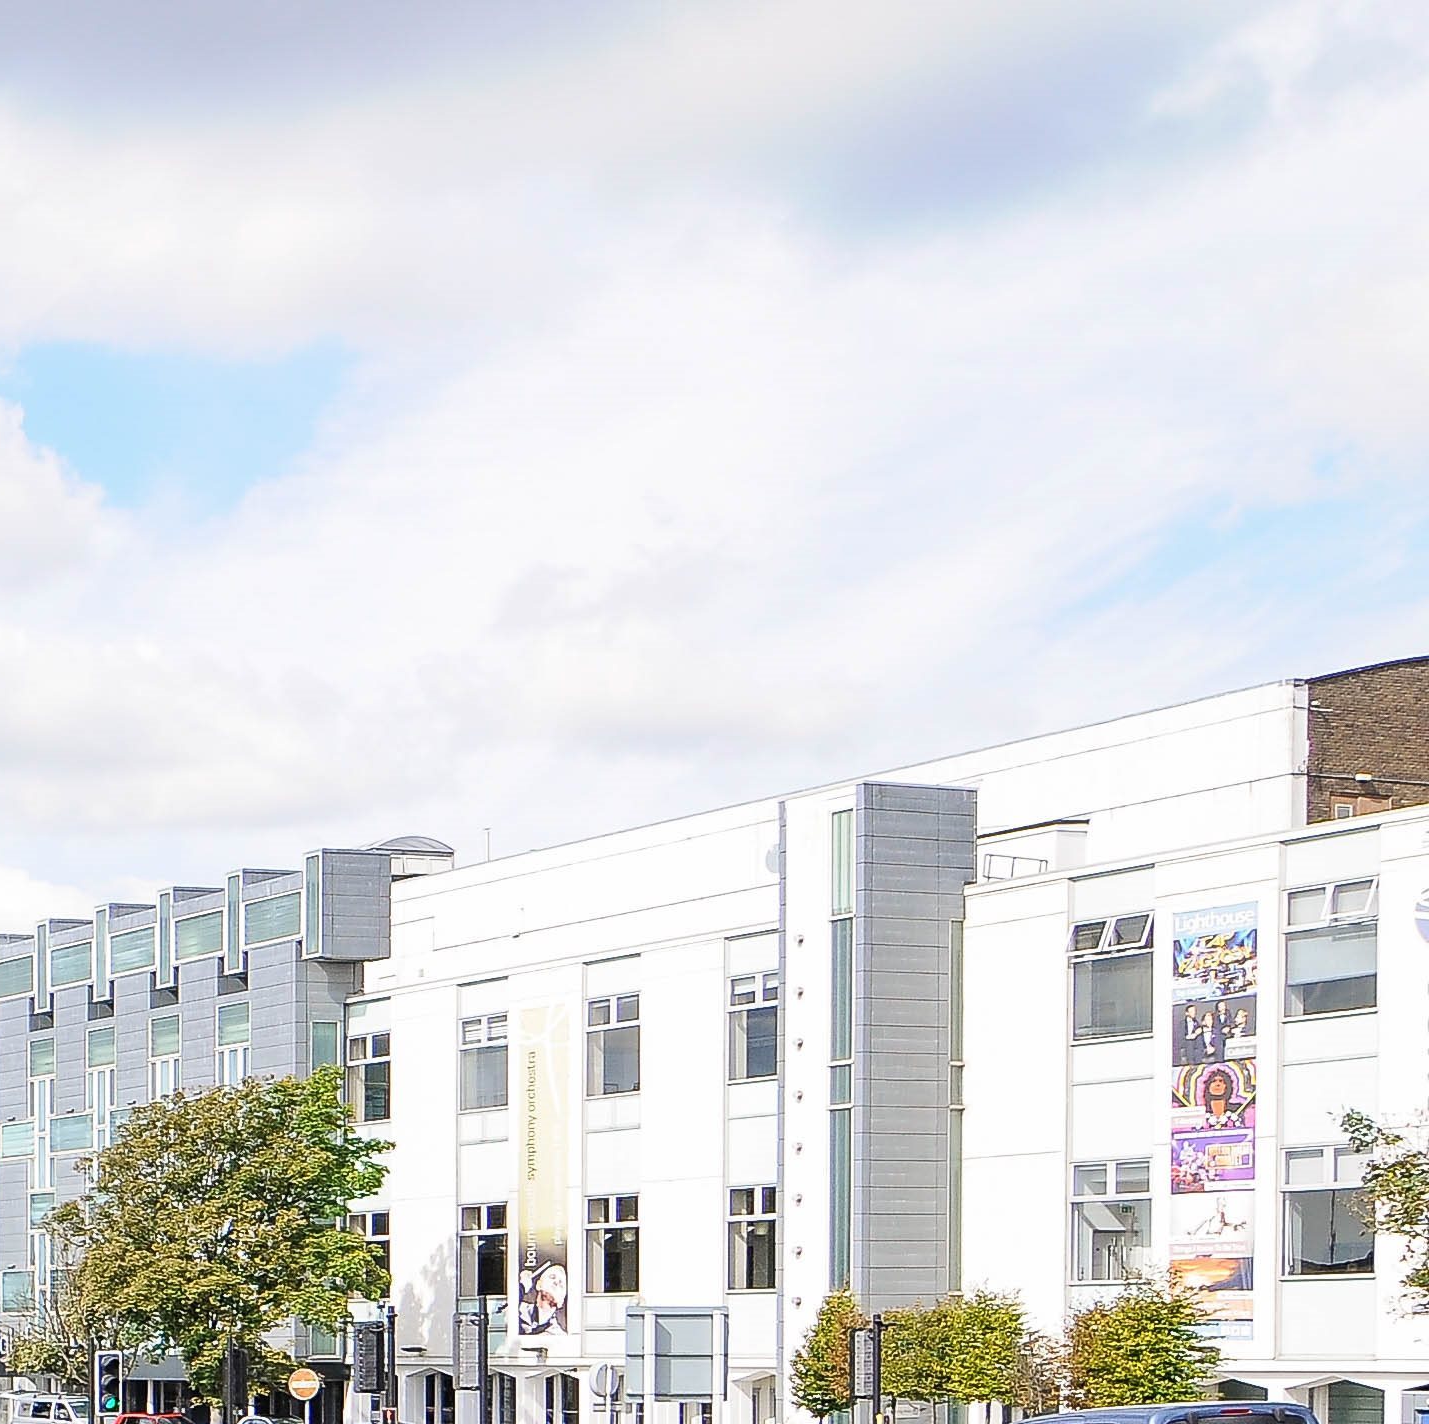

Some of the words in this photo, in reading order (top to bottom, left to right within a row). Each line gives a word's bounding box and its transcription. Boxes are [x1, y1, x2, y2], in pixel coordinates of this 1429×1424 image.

[1174, 910, 1254, 934] Lighthouse
[526, 1051, 537, 1112] orchestra
[526, 1115, 538, 1181] symphony
